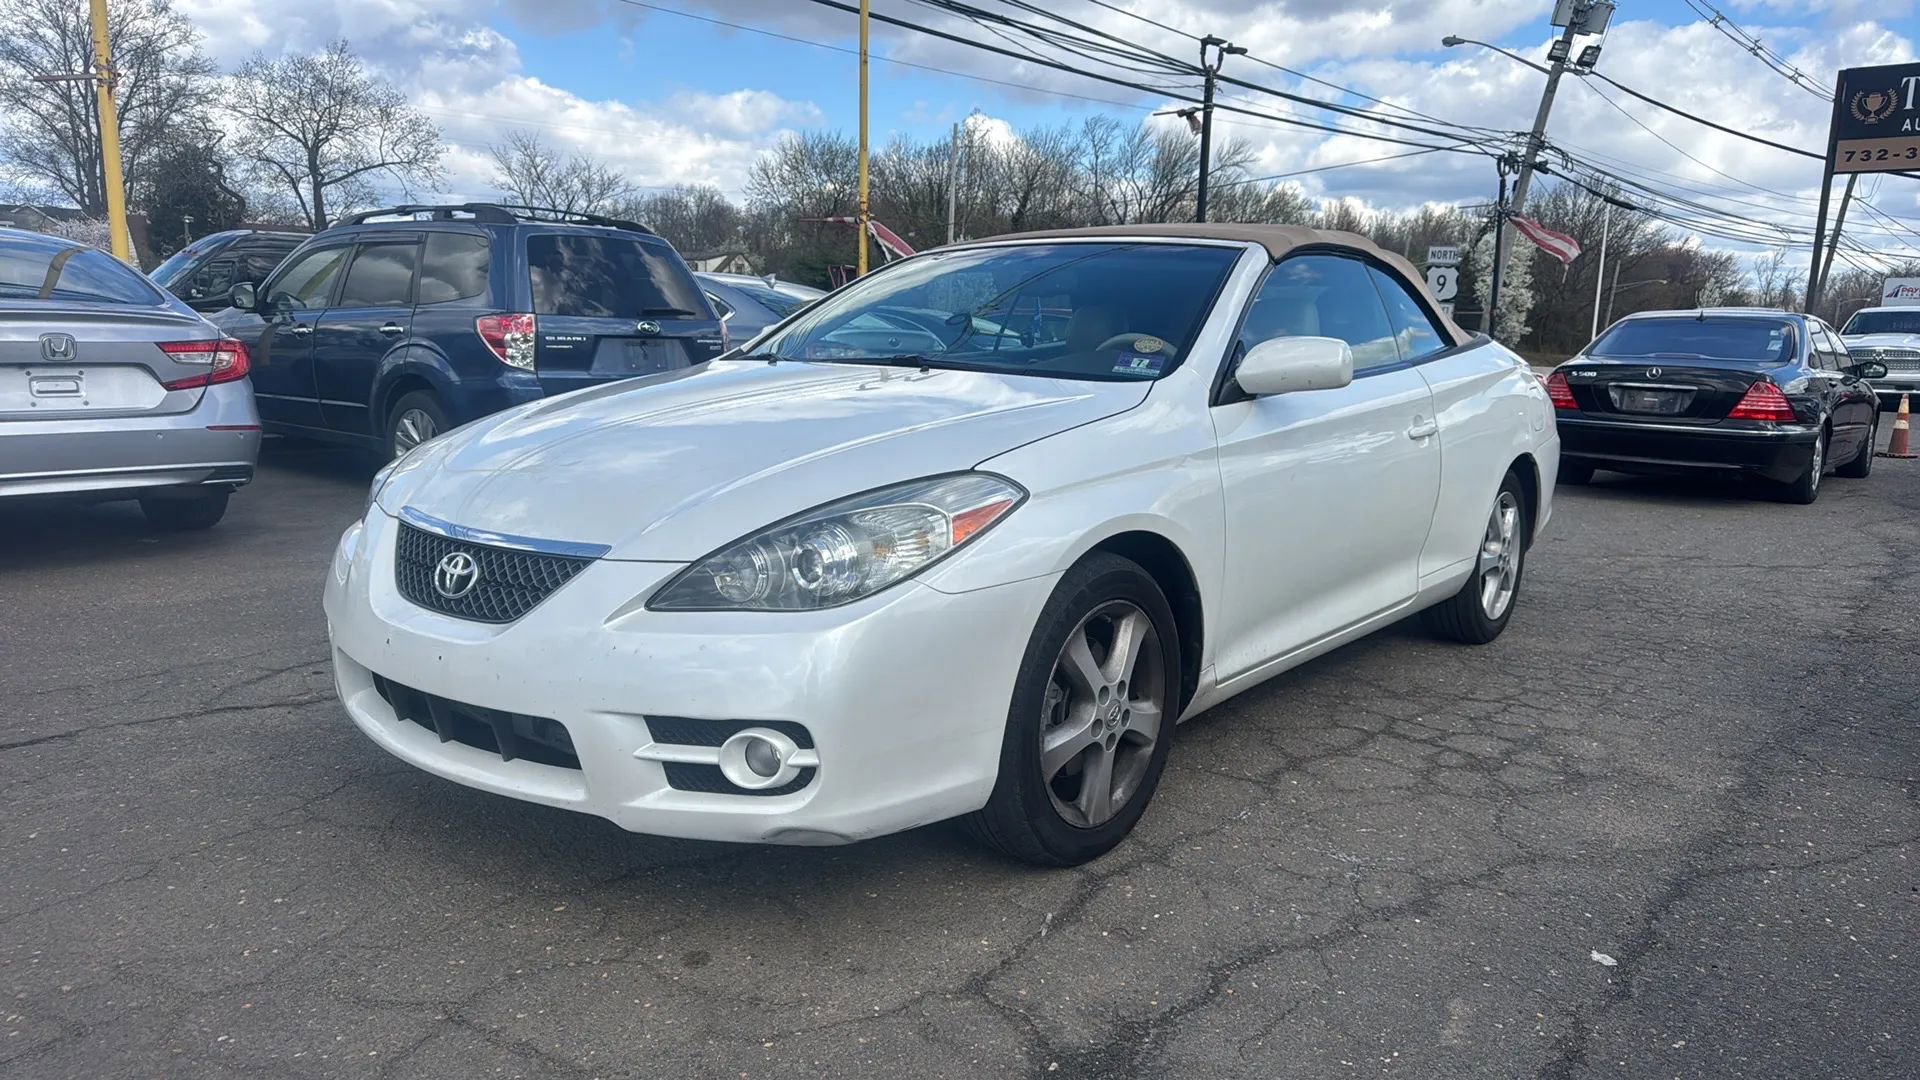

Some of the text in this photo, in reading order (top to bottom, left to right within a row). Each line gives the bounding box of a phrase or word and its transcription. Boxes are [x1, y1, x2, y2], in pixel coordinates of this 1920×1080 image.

[1844, 147, 1918, 163] 732-3
[1430, 250, 1459, 261] NORTH
[1436, 274, 1447, 293] 9
